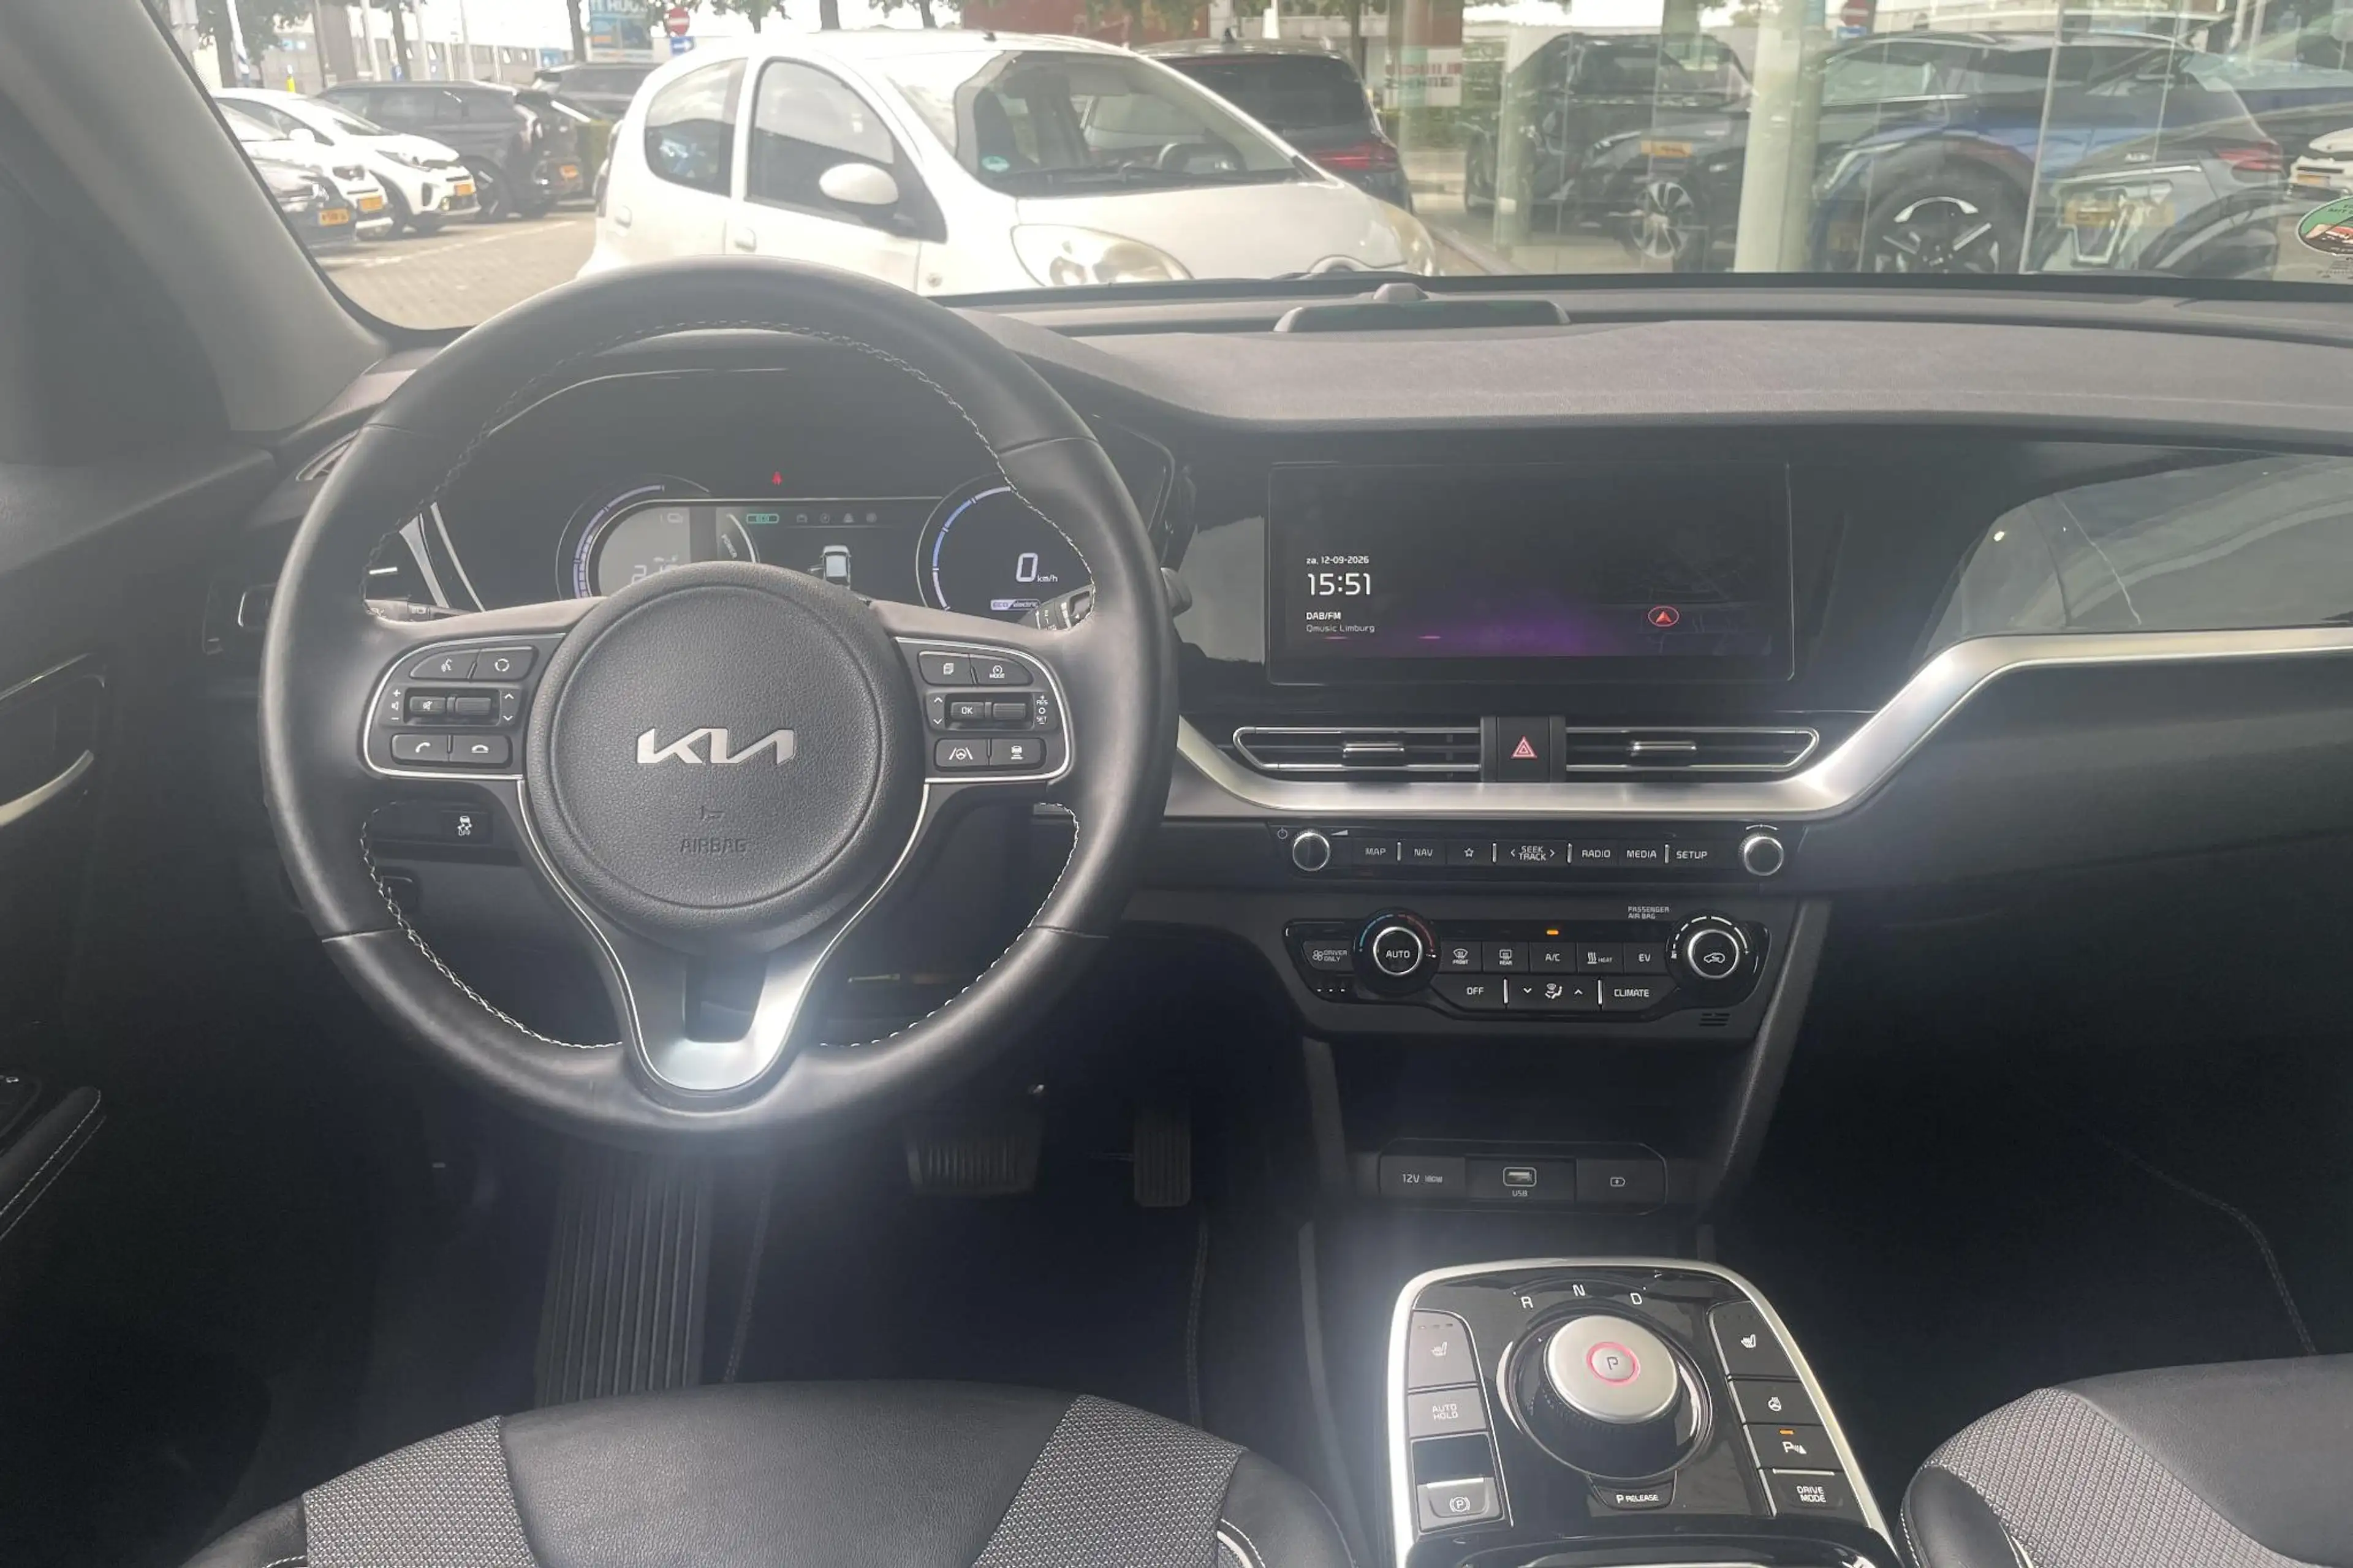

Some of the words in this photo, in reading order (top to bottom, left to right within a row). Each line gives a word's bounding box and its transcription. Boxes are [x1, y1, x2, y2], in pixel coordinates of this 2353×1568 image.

[1016, 553, 1039, 582] 0
[1308, 573, 1371, 595] 15:51
[1339, 624, 1375, 633] Limburg
[637, 727, 797, 765] KIA
[1365, 847, 1386, 856] MAP
[1414, 848, 1434, 857] NAV
[1519, 852, 1547, 861] TRACK
[1582, 849, 1610, 858] RADIO
[1676, 850, 1708, 859] SETUP
[1466, 987, 1484, 995] OFF
[1614, 989, 1650, 998] CLIMATE
[1402, 1173, 1420, 1183] 12V
[1572, 1284, 1586, 1297] N
[1520, 1296, 1534, 1309] R
[1630, 1292, 1643, 1305] D
[1607, 1357, 1619, 1370] P
[1433, 1403, 1457, 1413] AUTO
[1433, 1412, 1458, 1421] HOLD
[1616, 1494, 1624, 1504] P
